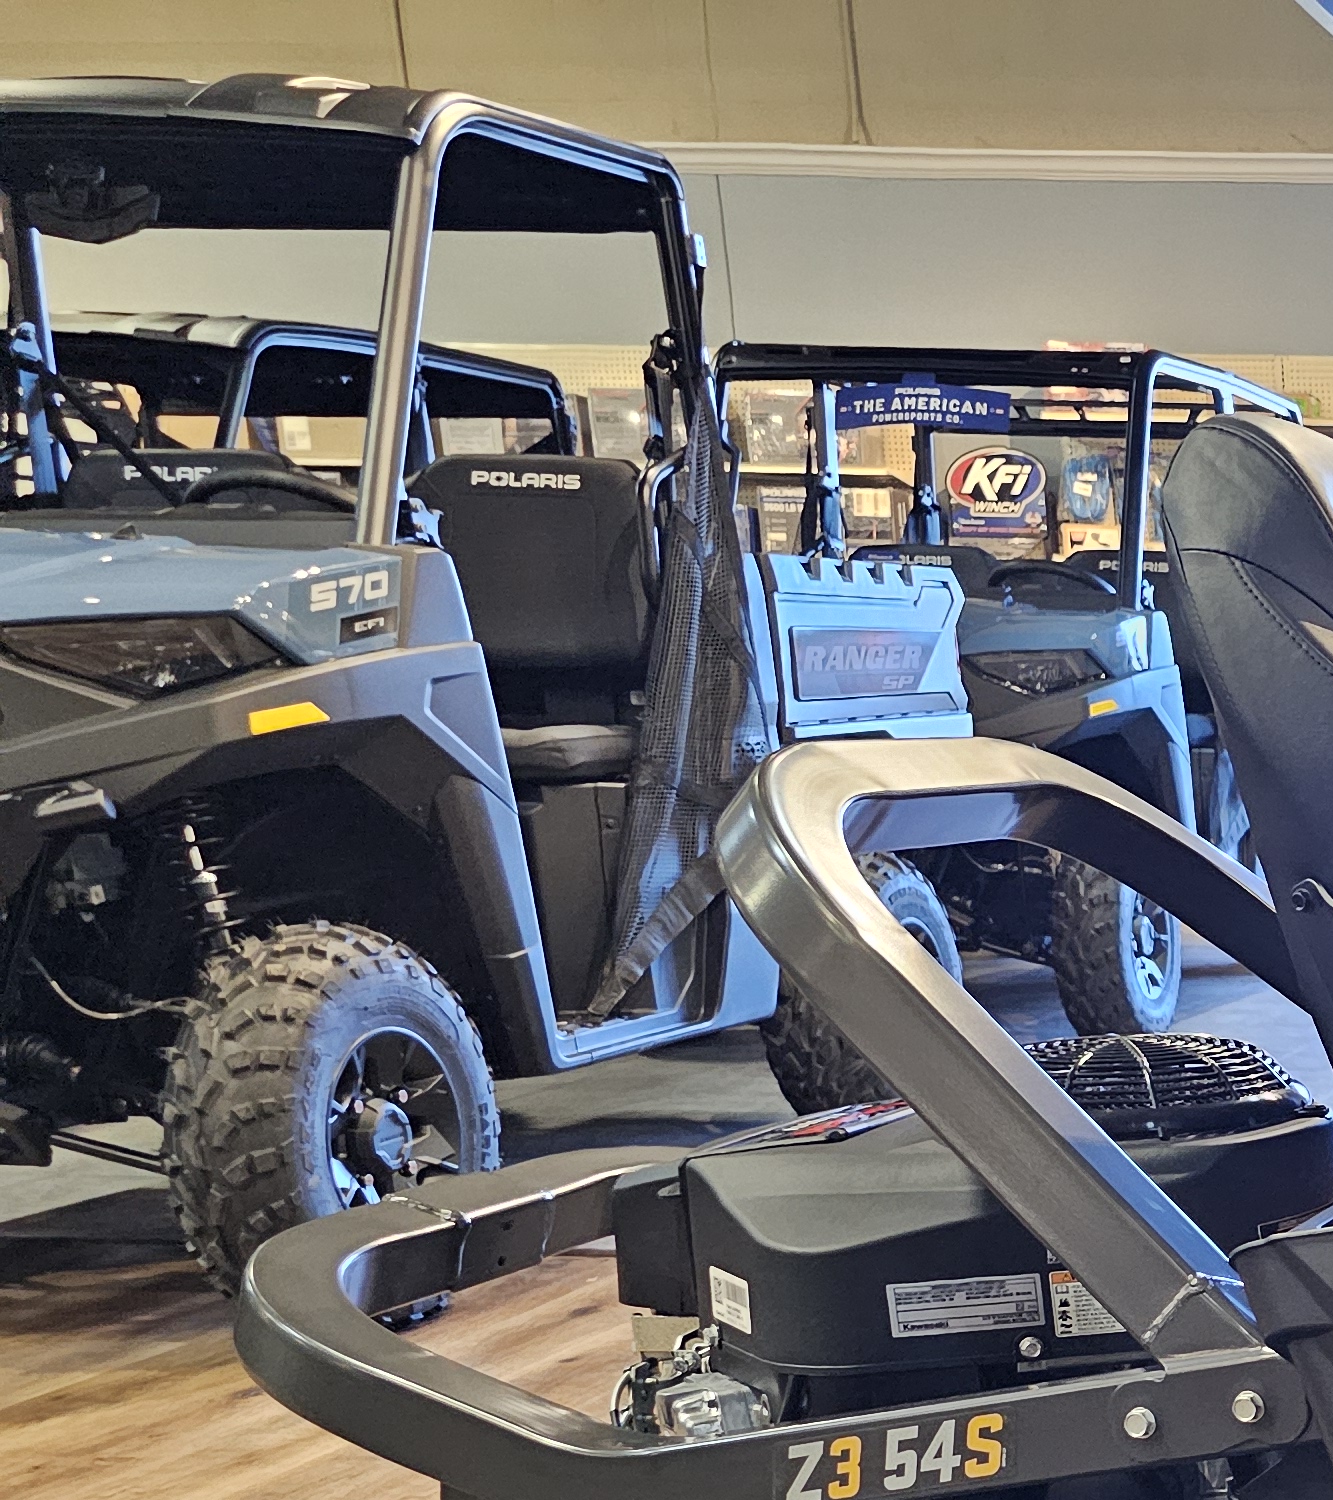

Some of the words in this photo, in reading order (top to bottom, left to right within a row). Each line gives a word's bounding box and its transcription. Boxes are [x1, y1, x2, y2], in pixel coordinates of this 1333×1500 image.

[853, 400, 886, 413] THE
[891, 397, 988, 416] AMERICAN
[872, 411, 943, 423] POWERSPORTS
[471, 470, 581, 490] POLARIS
[975, 501, 1021, 513] WINCH
[310, 568, 388, 612] 570
[804, 645, 924, 673] RANGER
[882, 676, 915, 690] SP
[883, 1412, 1003, 1491] 54S
